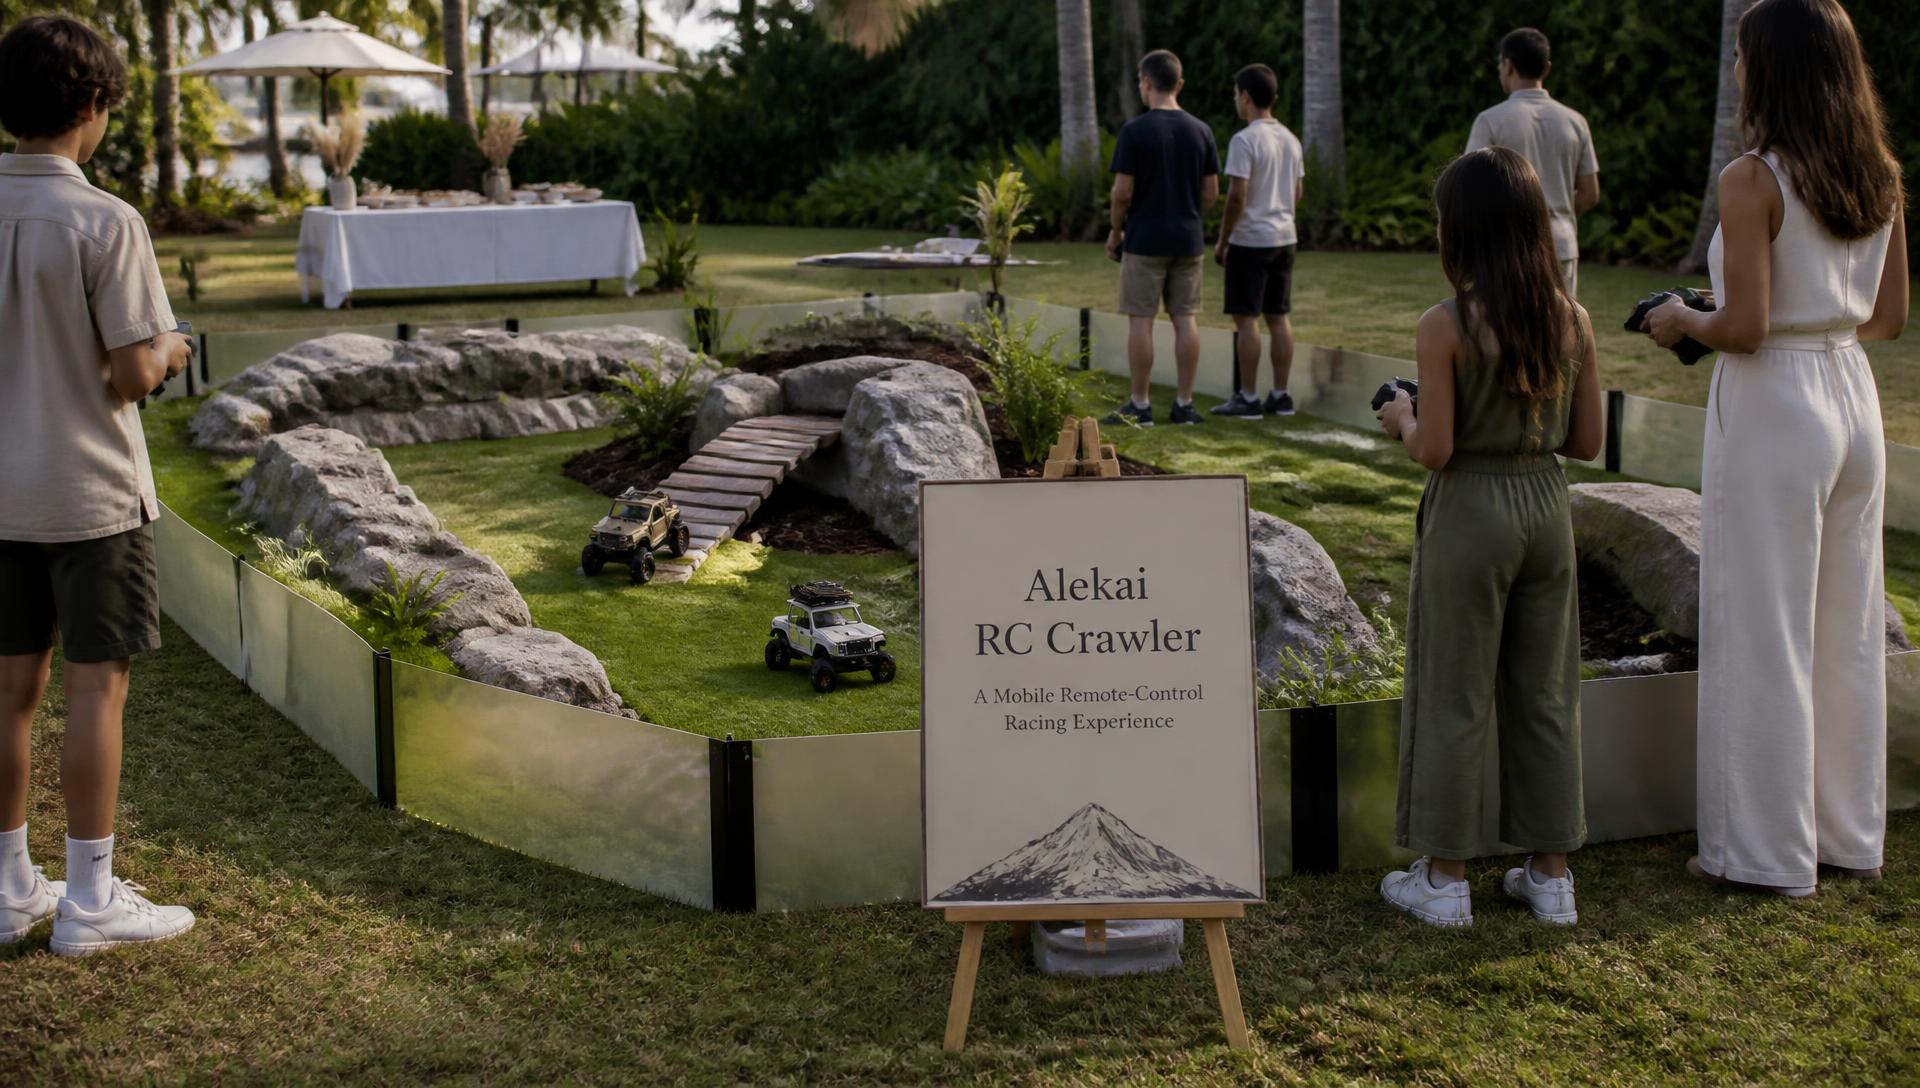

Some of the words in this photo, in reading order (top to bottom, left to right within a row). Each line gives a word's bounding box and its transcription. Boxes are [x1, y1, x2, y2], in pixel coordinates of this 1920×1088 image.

[1024, 567, 1148, 602] Alekai
[974, 622, 1032, 655] RC
[1047, 618, 1201, 654] Crawler
[974, 689, 988, 704] A
[994, 688, 1056, 704] Mobile
[1060, 683, 1204, 704] Remote-Control
[1004, 715, 1069, 735] Racing
[1072, 713, 1176, 734] Experience
